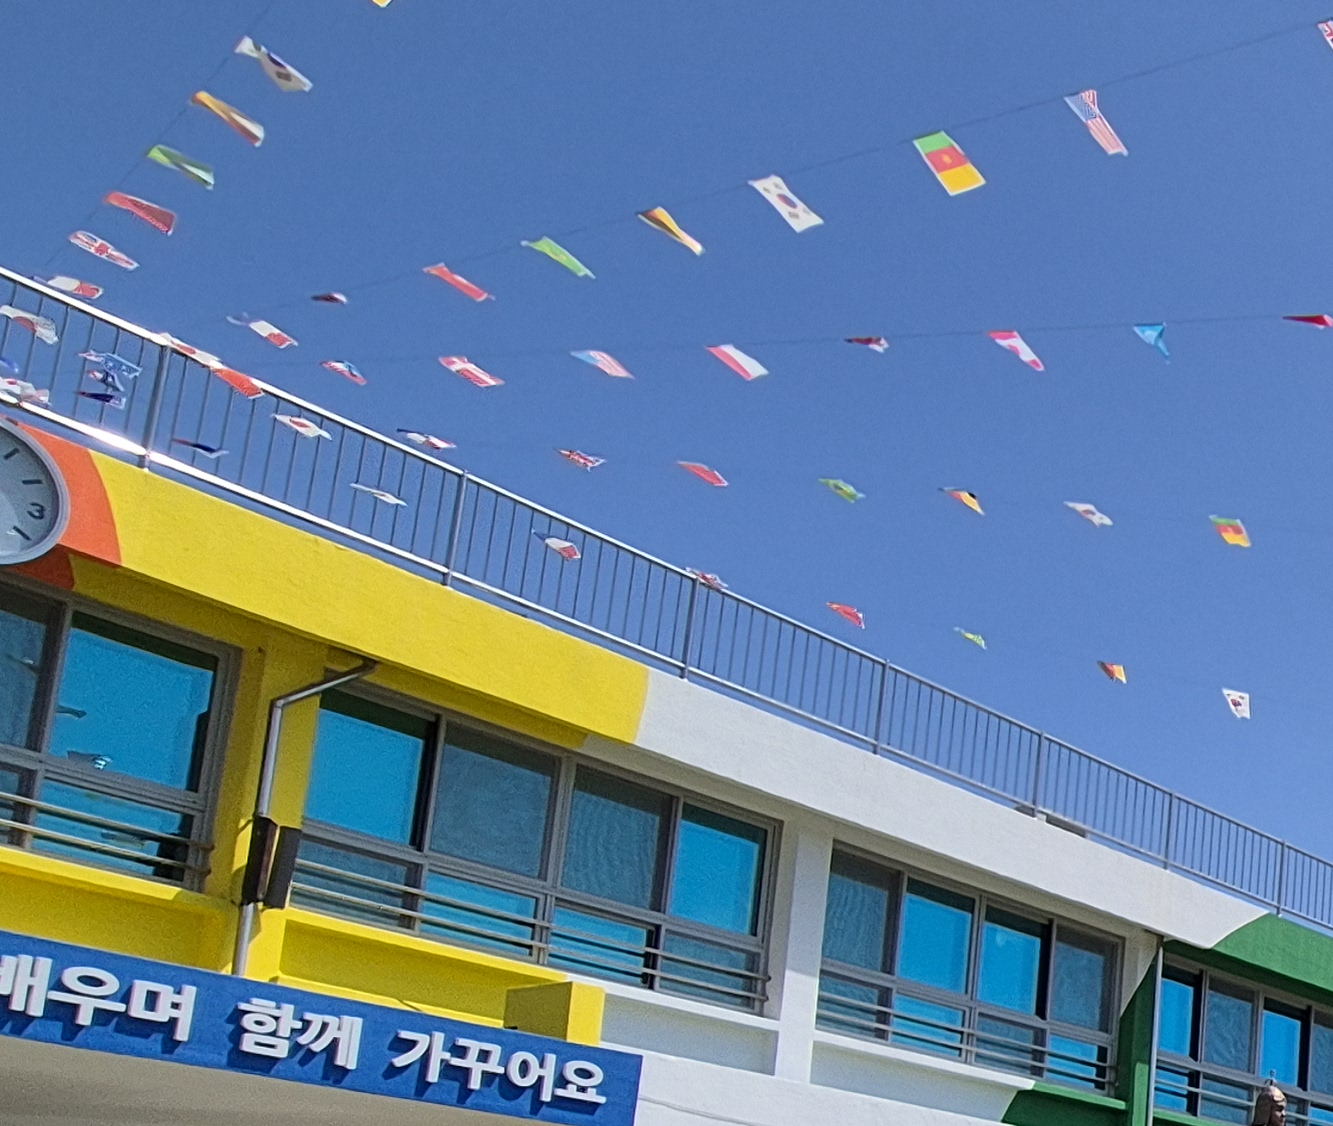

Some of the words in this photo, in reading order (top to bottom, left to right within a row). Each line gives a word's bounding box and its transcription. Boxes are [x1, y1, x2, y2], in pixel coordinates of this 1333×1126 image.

[26, 502, 46, 520] 3
[0, 954, 197, 1042] 배우며
[237, 997, 363, 1070] 함께
[391, 1030, 607, 1105] 가꾸어요
